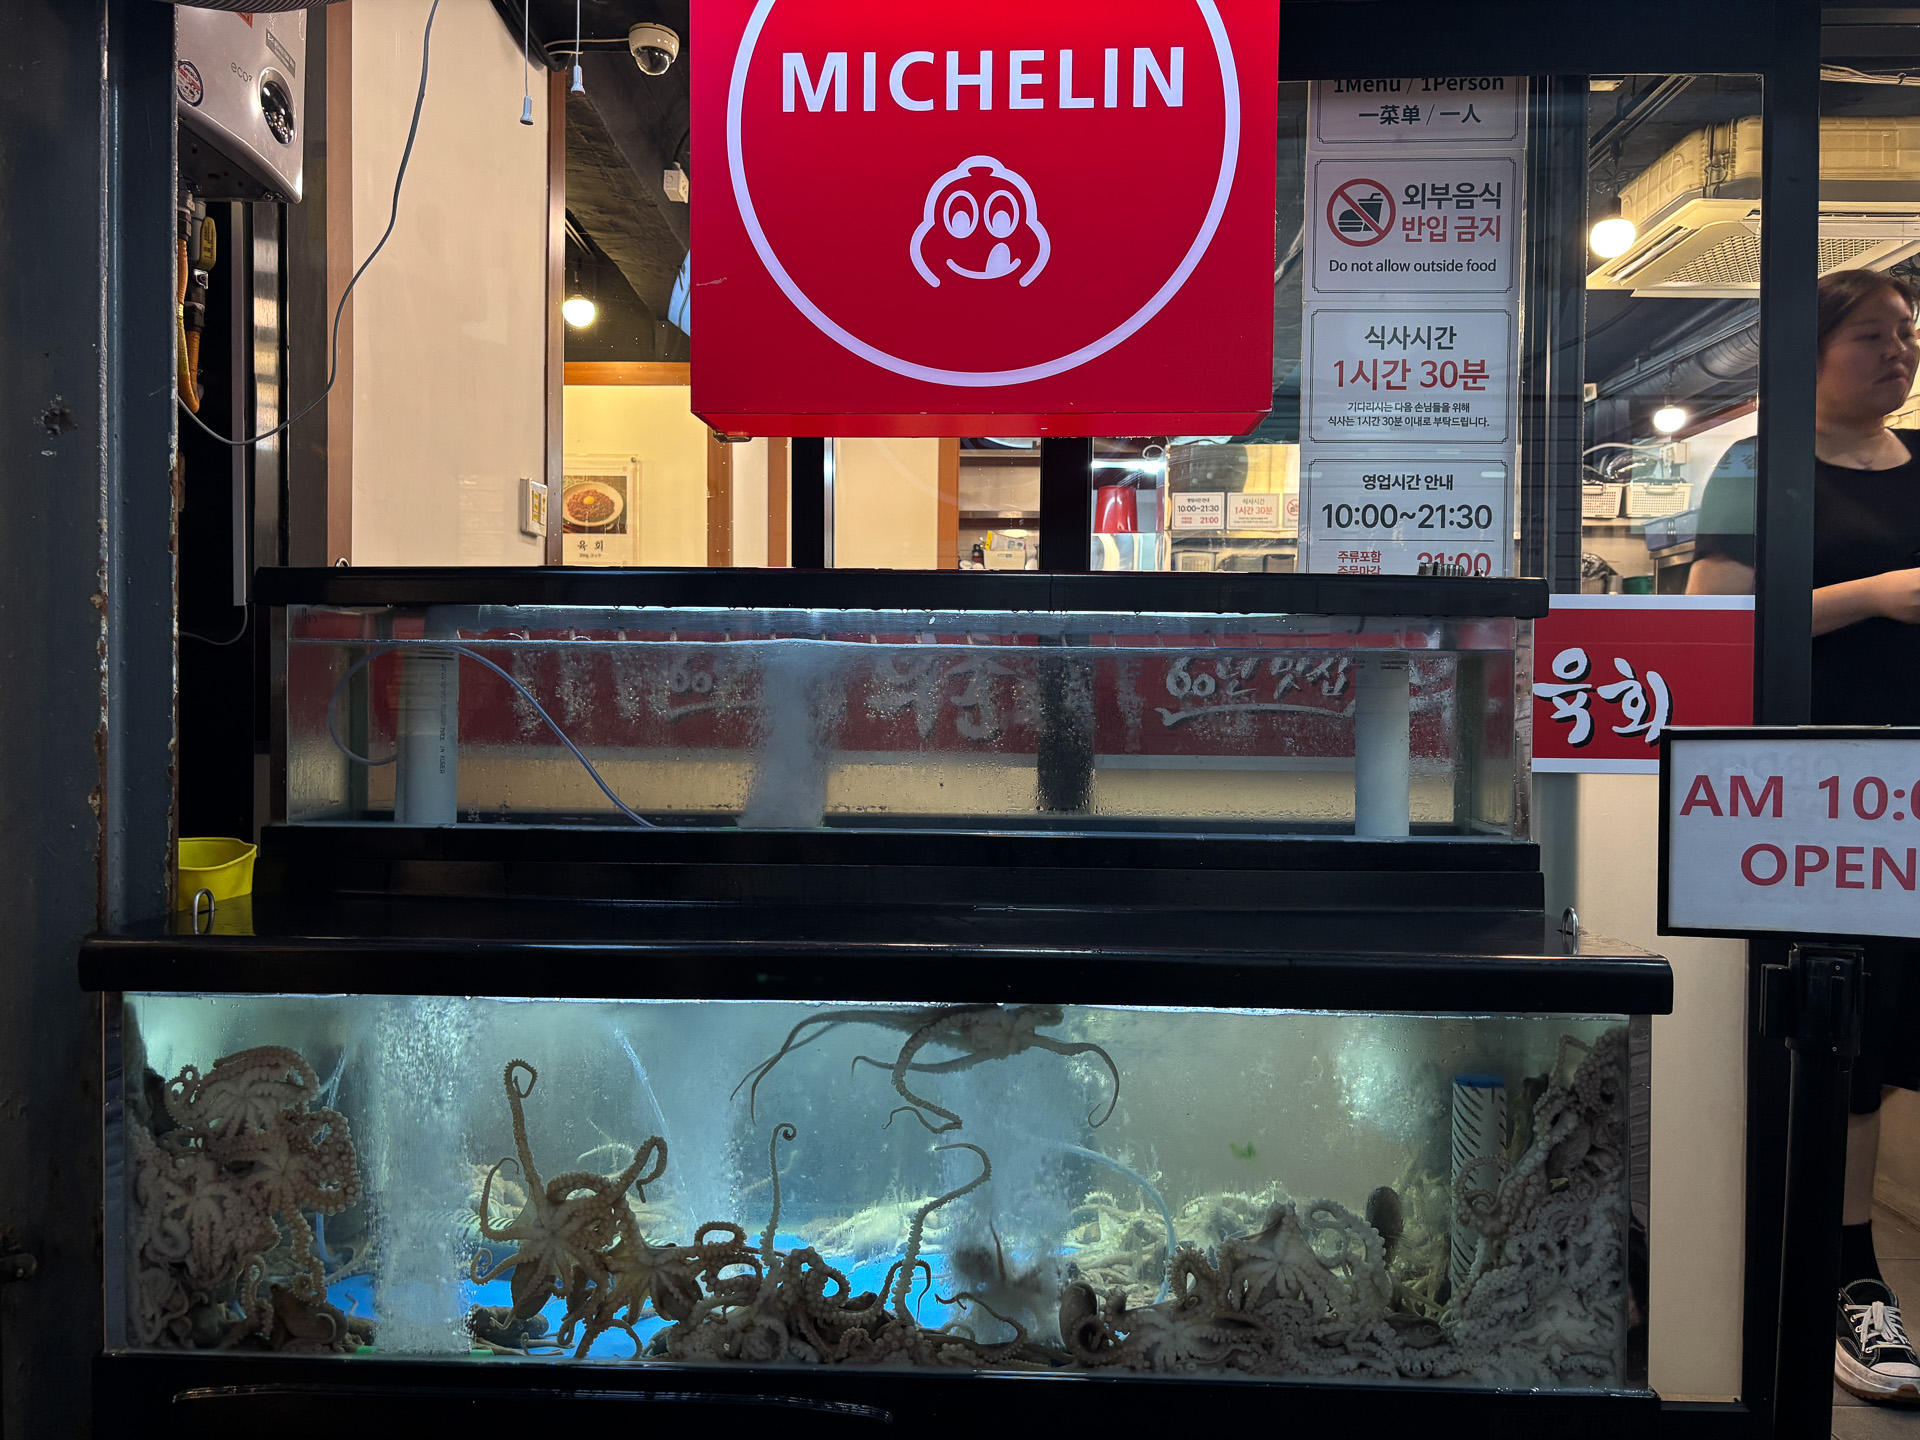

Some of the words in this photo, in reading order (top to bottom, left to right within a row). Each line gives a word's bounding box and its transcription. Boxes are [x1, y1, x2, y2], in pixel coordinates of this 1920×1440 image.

[782, 47, 1184, 113] MICHELIN
[1334, 79, 1401, 93] 1Menu
[1421, 77, 1504, 92] 1Person
[1359, 104, 1420, 125] 一菜单
[1440, 104, 1481, 124] 一人
[1402, 182, 1501, 210] 외부음식
[1402, 215, 1447, 242] 반입
[1454, 215, 1500, 242] 금지
[1329, 260, 1348, 272] Do
[1351, 260, 1373, 272] not
[1376, 259, 1410, 272] allow
[1414, 259, 1463, 272] outside
[1466, 259, 1496, 272] food
[1364, 326, 1457, 350] 식사시간
[1333, 359, 1412, 391] 1시간
[1419, 359, 1490, 391] 30분
[1348, 402, 1393, 413] 기다리시는
[1394, 402, 1412, 413] 다음
[1414, 402, 1450, 413] 손님들을
[1452, 402, 1470, 413] 위해
[1327, 416, 1355, 427] 식사는
[1357, 416, 1380, 427] 1시간
[1382, 416, 1403, 427] 30분
[1404, 416, 1431, 427] 이내로
[1433, 416, 1490, 427] 부탁드립니다.
[1362, 474, 1421, 490] 영업시간
[1424, 474, 1453, 490] 안내
[1235, 507, 1254, 515] 1시간
[1256, 507, 1273, 515] 30분
[1322, 503, 1492, 529] 10:00~21:30
[1338, 550, 1381, 563] 주류포함
[1532, 647, 1671, 746] 육회
[1679, 774, 1784, 818] AM
[1818, 776, 1920, 821] 10:
[1740, 843, 1917, 891] OPEN
